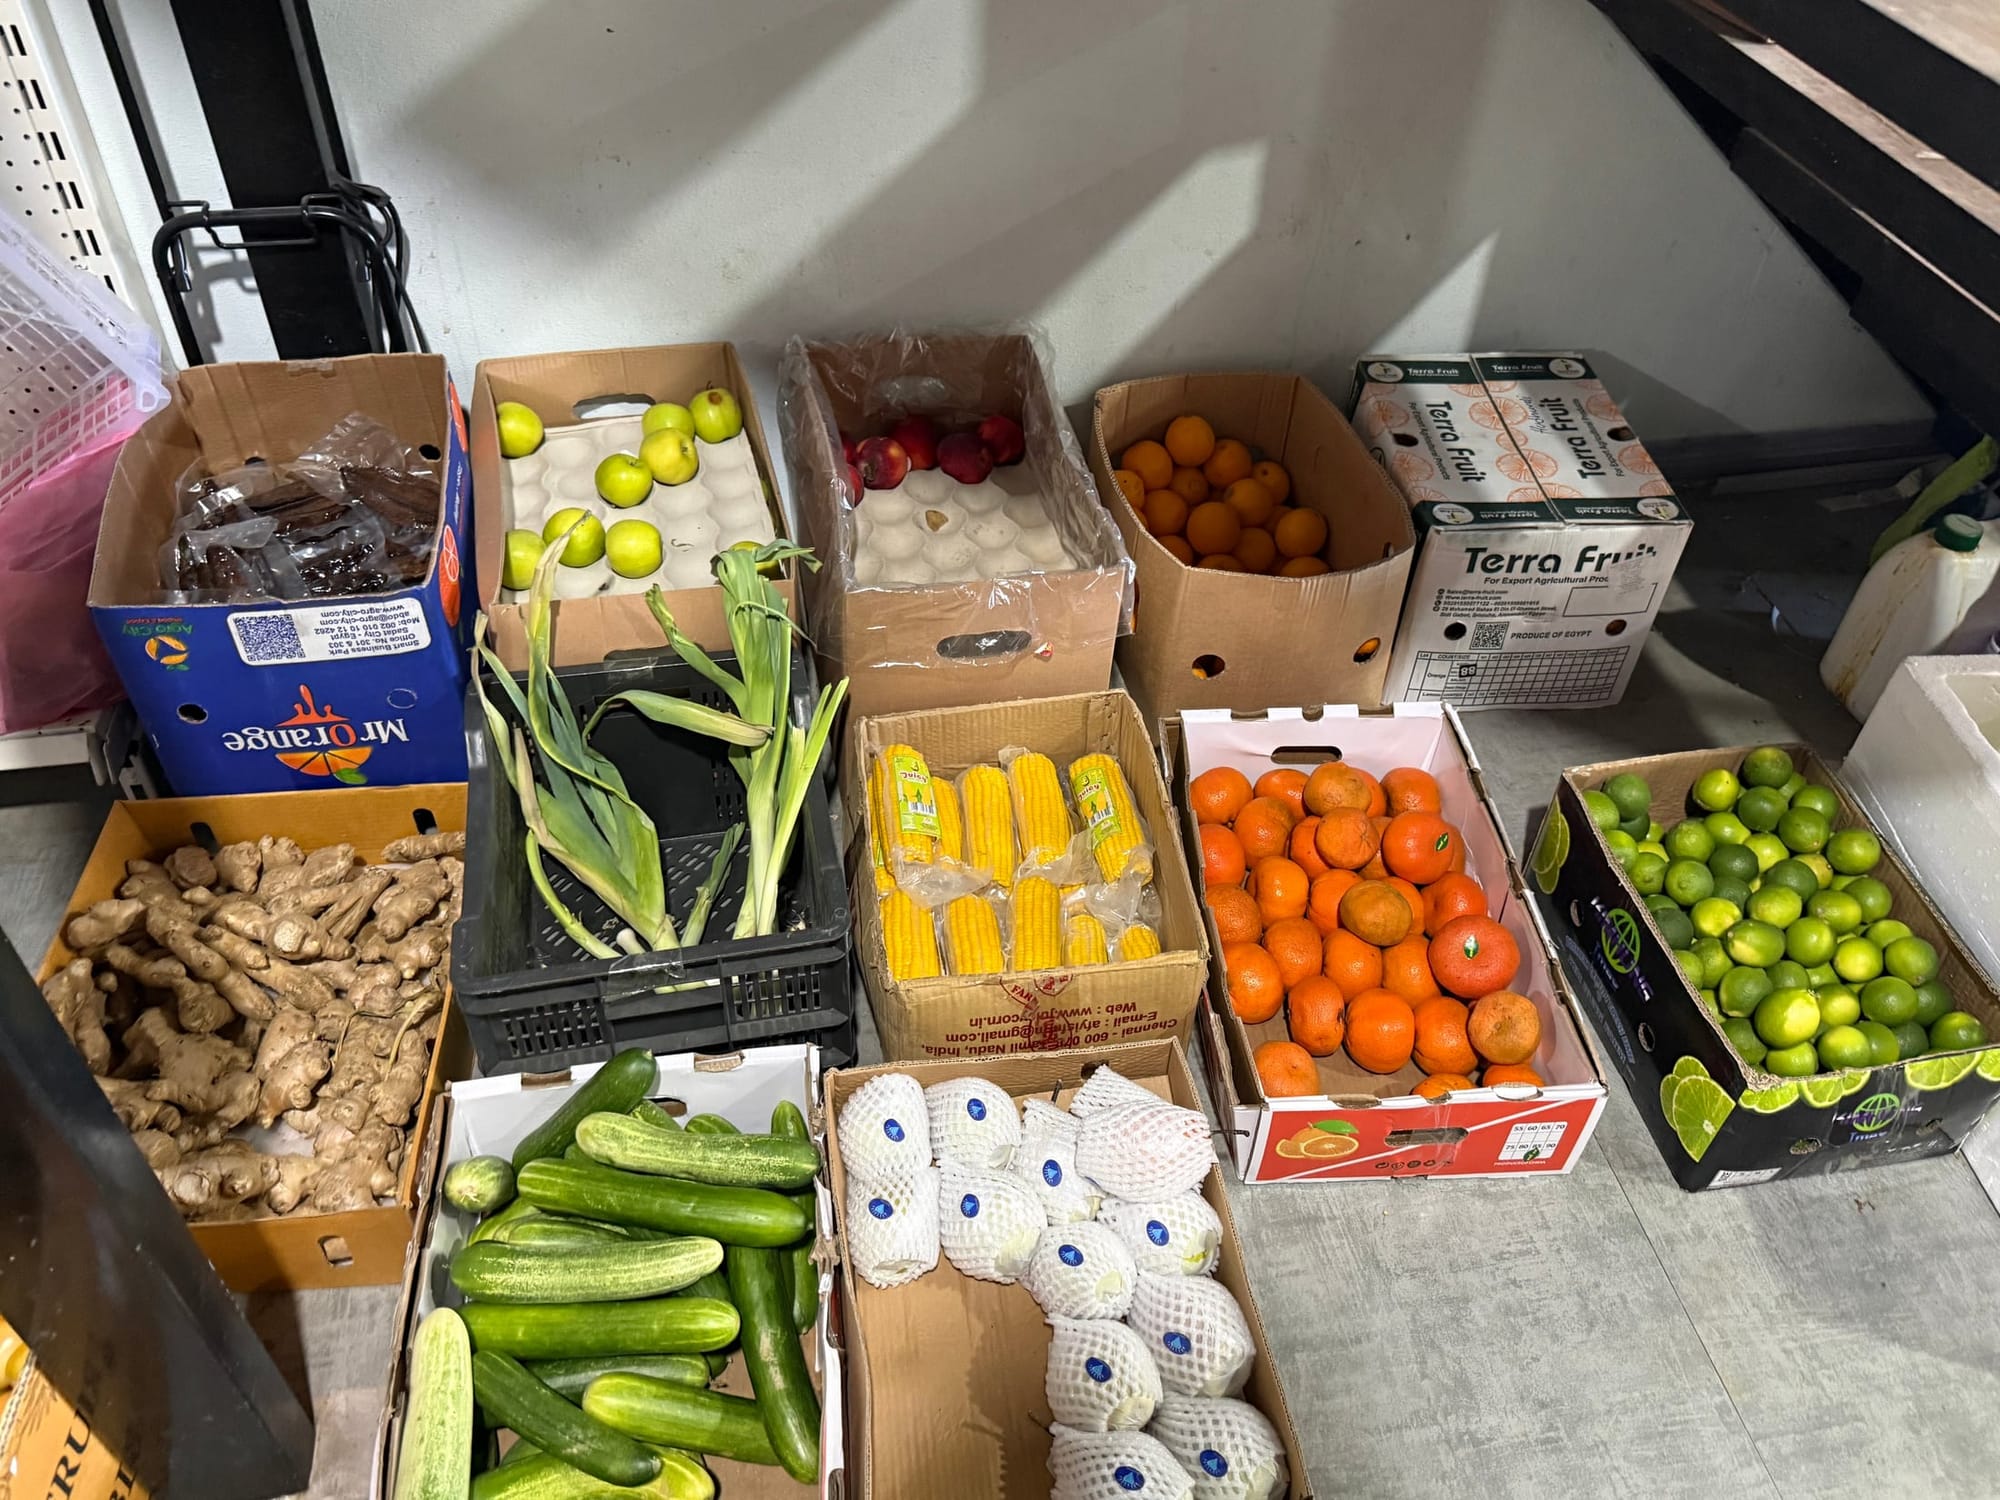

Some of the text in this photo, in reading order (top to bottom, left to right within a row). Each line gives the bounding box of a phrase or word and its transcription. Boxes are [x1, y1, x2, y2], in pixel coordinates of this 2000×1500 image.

[1538, 397, 1578, 431] Fruit
[1425, 401, 1487, 482] Terra Fruit
[1567, 436, 1607, 480] Terra
[1464, 547, 1562, 574] Terra
[1501, 577, 1532, 586] Export
[1534, 576, 1587, 586] Agricultural
[320, 604, 404, 618] www.agro-city.com
[320, 611, 410, 626] abdo@agro-city.com
[398, 616, 420, 626] Mob:
[380, 621, 397, 629] 002
[330, 632, 357, 641] Egypt
[364, 630, 381, 638] City
[383, 627, 409, 636] Sadat
[389, 633, 416, 641] Office
[1510, 631, 1550, 640] PRODUCE
[1565, 630, 1592, 638] EGYPT
[328, 640, 420, 656] Smart Business Park
[223, 718, 410, 751] Mr Orange
[1106, 1002, 1137, 1014] Web
[1113, 1010, 1158, 1027] E-mail
[1121, 1018, 1178, 1038] Chennai
[1084, 1032, 1109, 1044] 600
[921, 1044, 961, 1057] India,
[965, 1044, 1005, 1056] Nadu,
